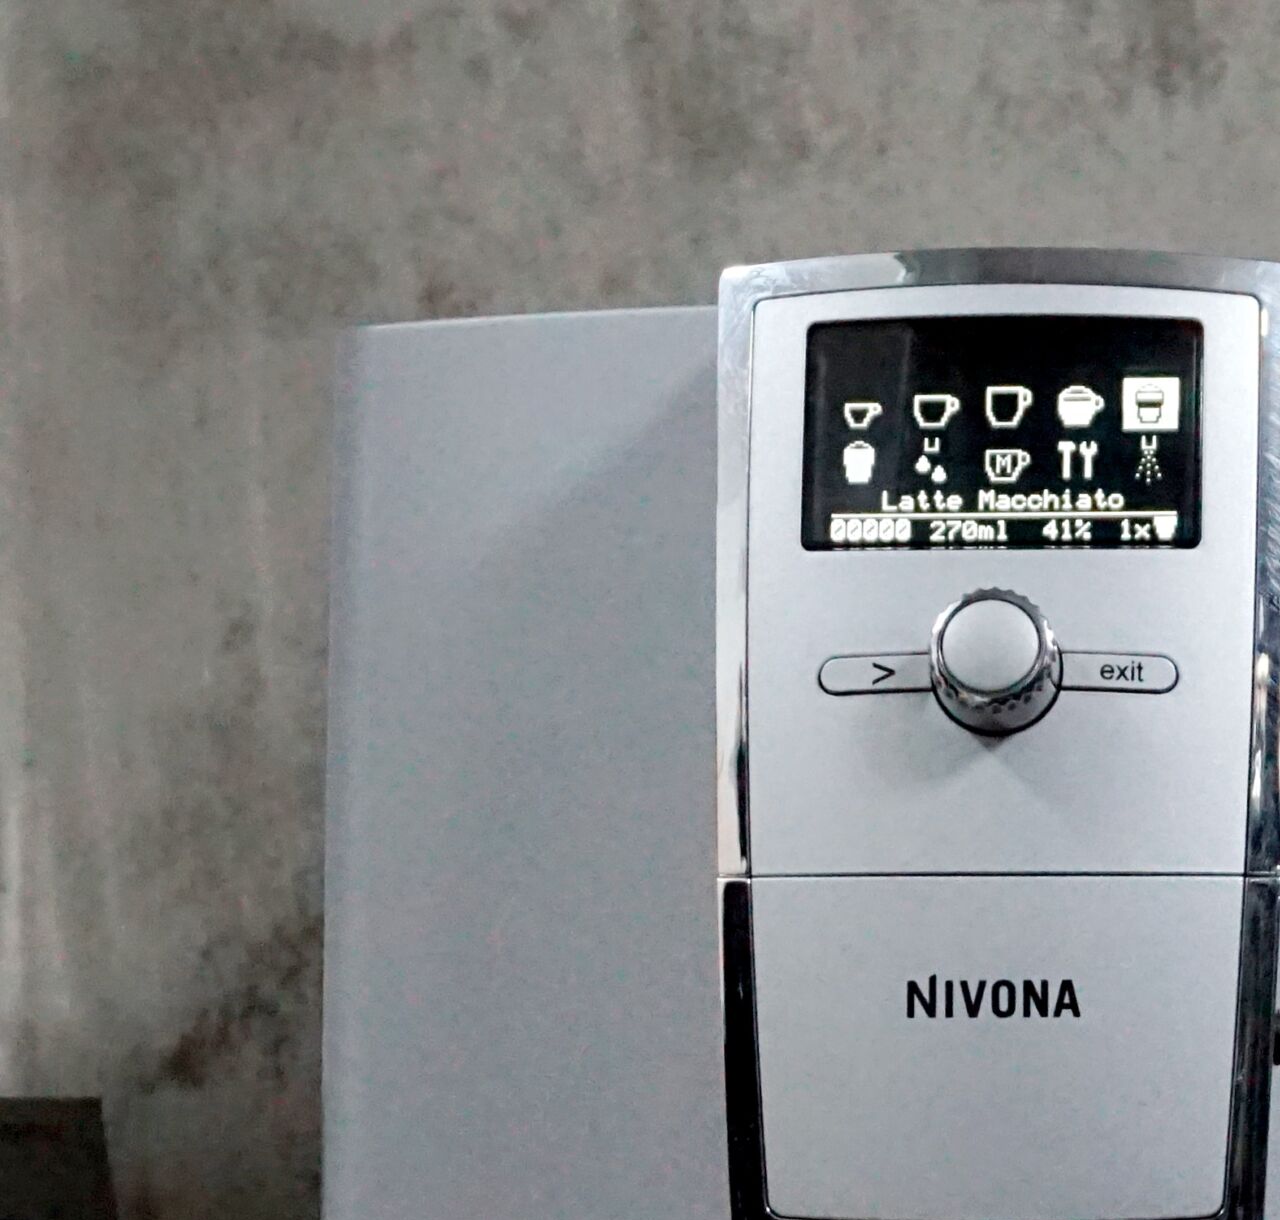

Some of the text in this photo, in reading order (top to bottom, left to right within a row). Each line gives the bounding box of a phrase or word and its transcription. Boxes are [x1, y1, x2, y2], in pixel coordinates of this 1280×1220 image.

[881, 488, 1125, 511] Latte Macchiato
[929, 518, 1150, 541] 270ml 41% 1x
[1099, 660, 1145, 682] exit
[906, 973, 1081, 1019] NIVONA
